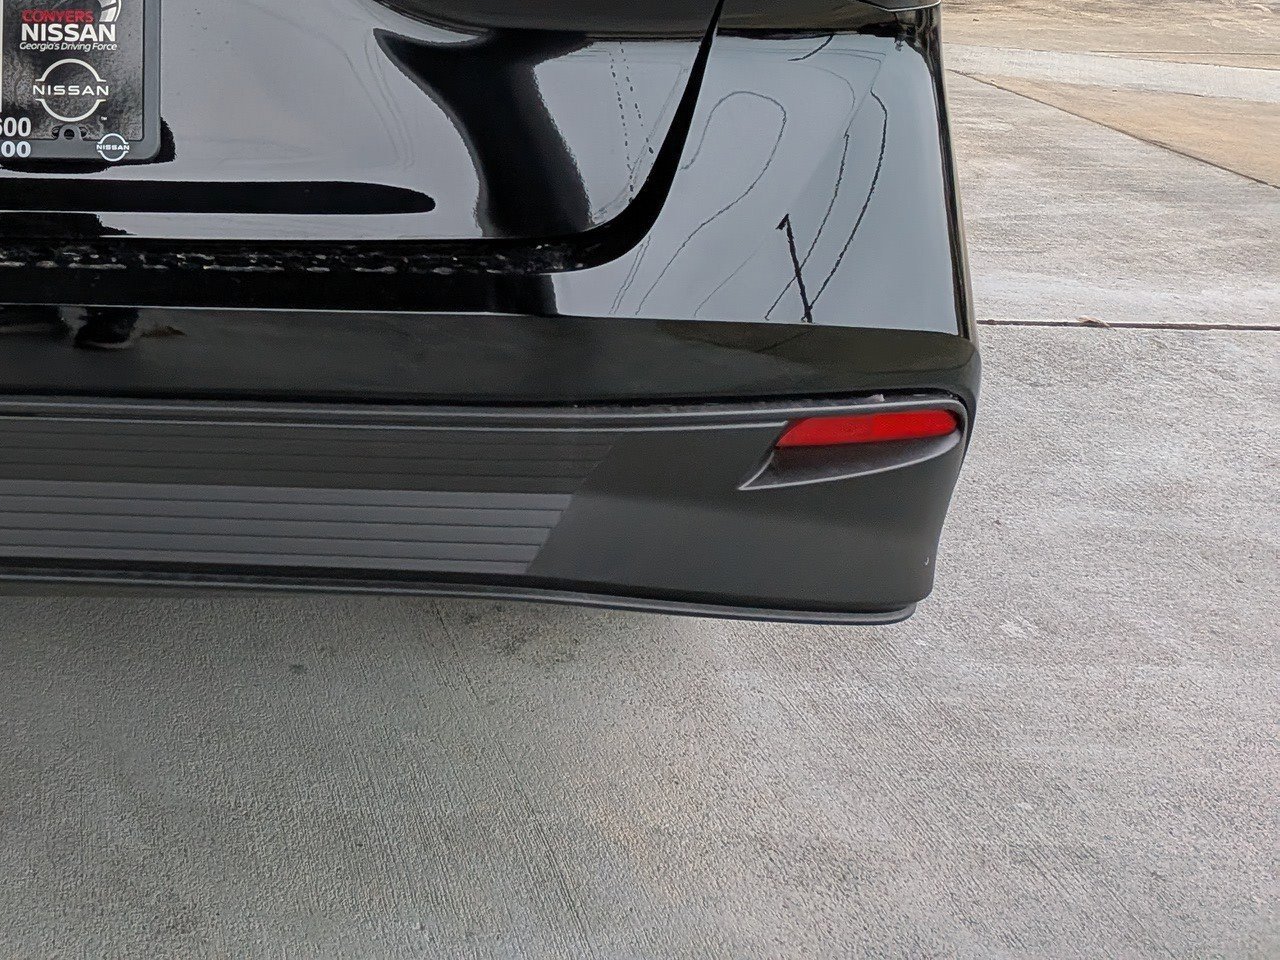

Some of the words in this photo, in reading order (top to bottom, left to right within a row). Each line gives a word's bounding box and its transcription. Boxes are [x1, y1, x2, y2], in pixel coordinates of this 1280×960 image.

[22, 9, 95, 22] CONYERS
[21, 23, 116, 42] NISSAN
[19, 41, 60, 52] Georgia's
[60, 42, 91, 52] Driving
[92, 42, 117, 51] Force
[32, 84, 109, 96] NISSAN
